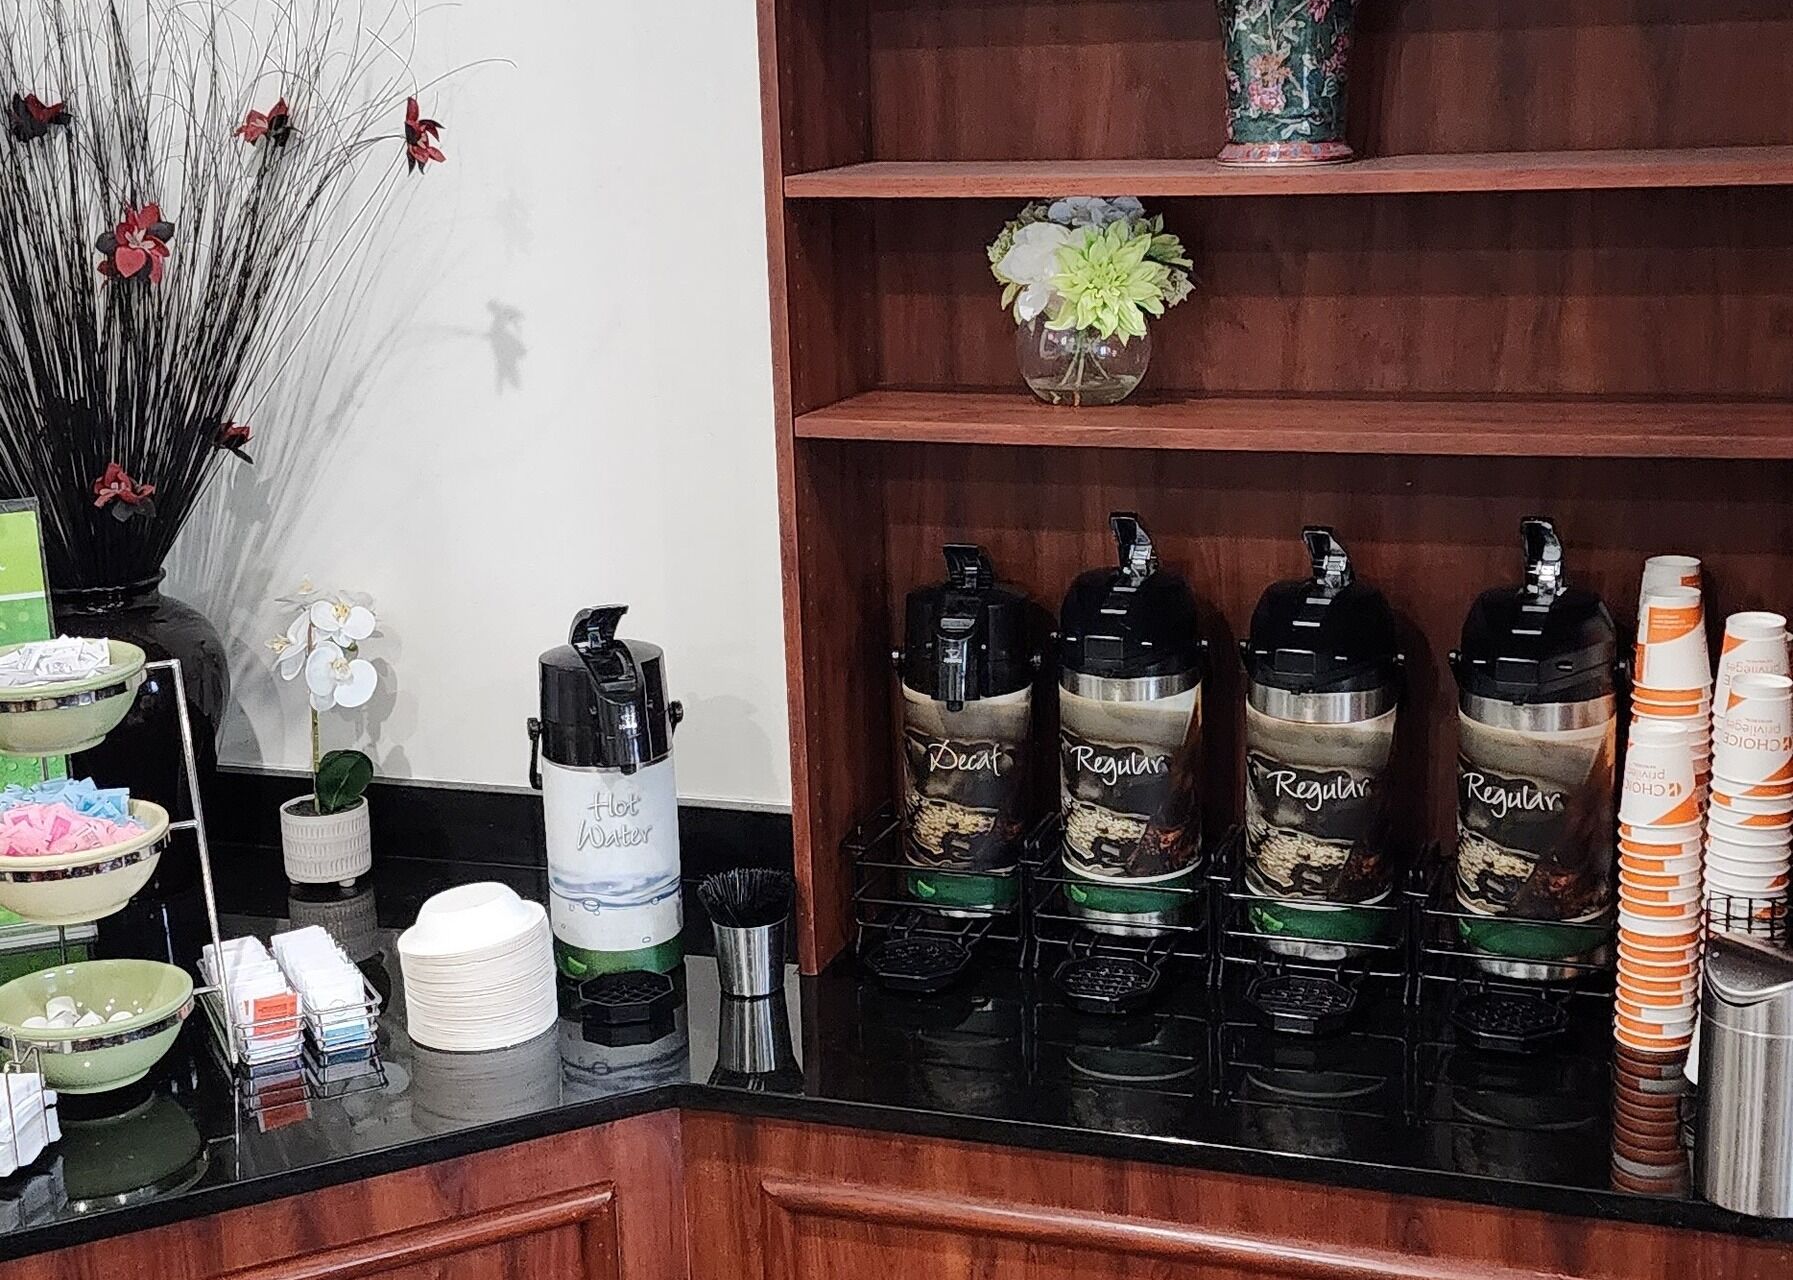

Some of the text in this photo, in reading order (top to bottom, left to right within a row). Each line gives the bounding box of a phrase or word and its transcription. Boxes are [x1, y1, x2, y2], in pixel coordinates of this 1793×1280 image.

[928, 739, 1002, 777] Decaf
[1723, 732, 1781, 752] CHOICE
[1069, 746, 1166, 786] Regular
[586, 792, 641, 821] Hot
[1266, 770, 1371, 811] Regular
[1462, 772, 1562, 819] Regular
[576, 819, 653, 852] Water
